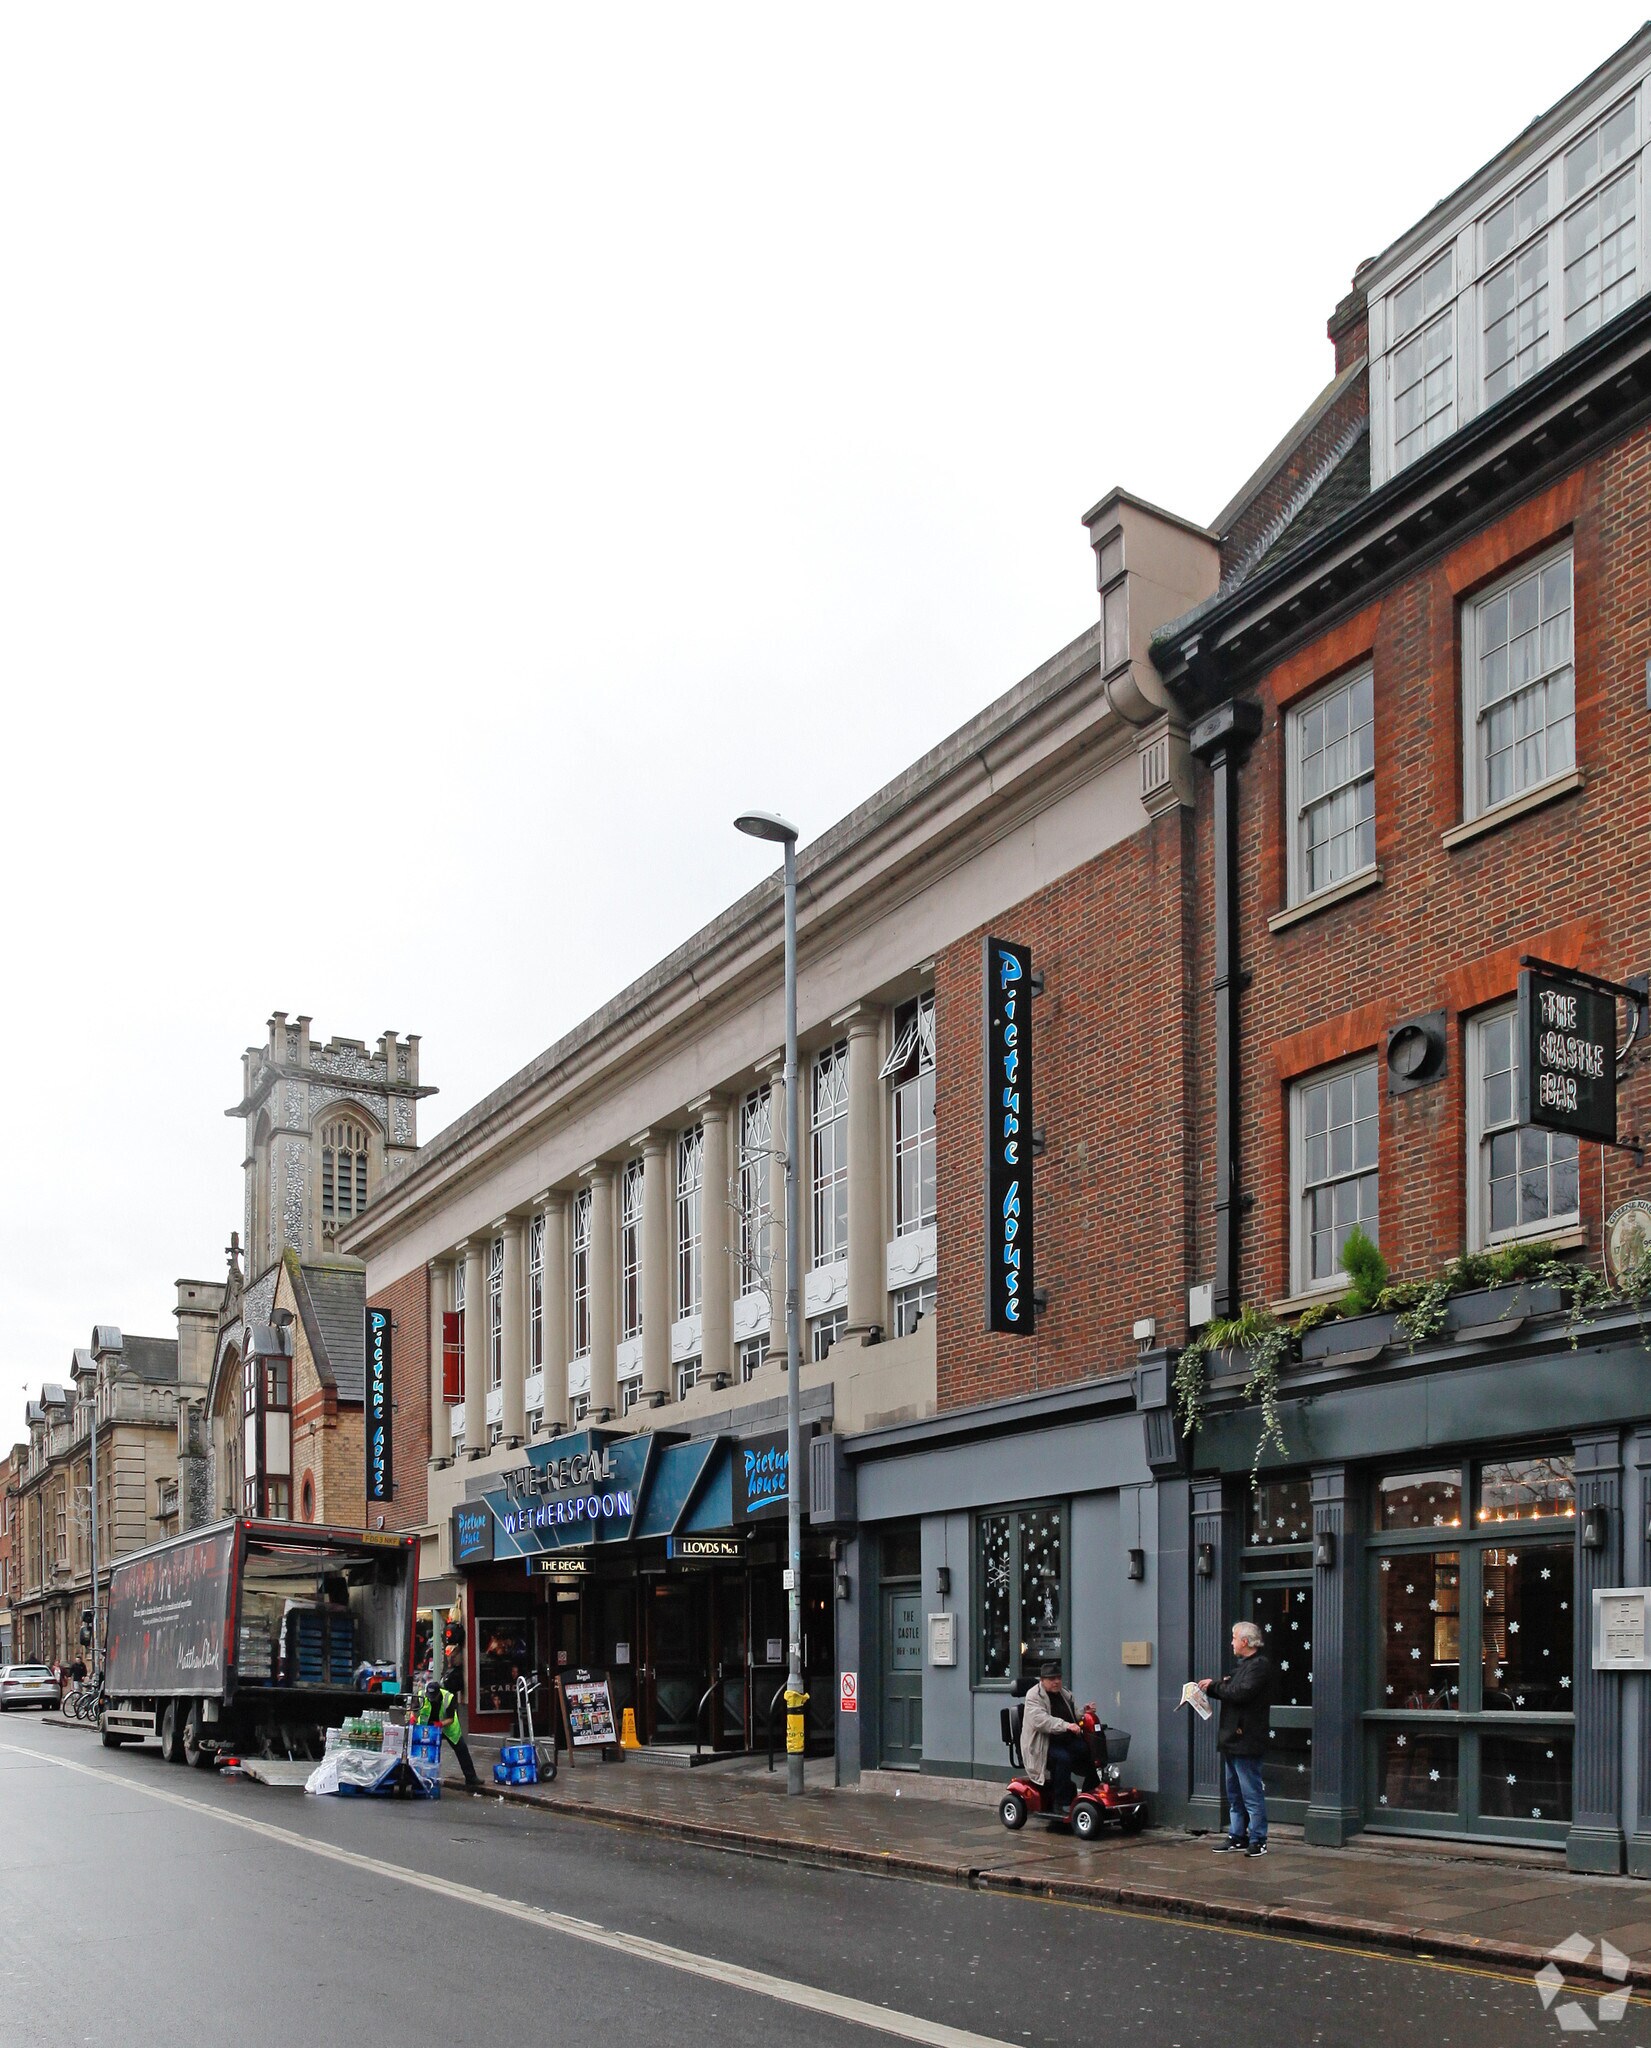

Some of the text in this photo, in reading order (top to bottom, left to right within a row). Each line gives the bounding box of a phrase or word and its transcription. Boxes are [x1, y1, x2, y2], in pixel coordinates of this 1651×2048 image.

[1540, 990, 1577, 1030] THE
[1541, 1031, 1604, 1079] CASTLE
[1541, 1072, 1577, 1112] BAR
[998, 949, 1023, 1322] Picture house
[1608, 1201, 1637, 1225] GREENE
[371, 1312, 386, 1497] Picture house
[502, 1449, 615, 1501] THE REGAL
[748, 1469, 786, 1498] house
[458, 1513, 486, 1533] Picture
[504, 1490, 631, 1534] WETHERSPOON
[460, 1528, 480, 1546] house
[683, 1542, 719, 1554] LLOYDS
[541, 1561, 587, 1571] THE REGAL
[903, 1610, 914, 1622] THE
[898, 1627, 920, 1639] CASTLE
[576, 1674, 591, 1682] Regal
